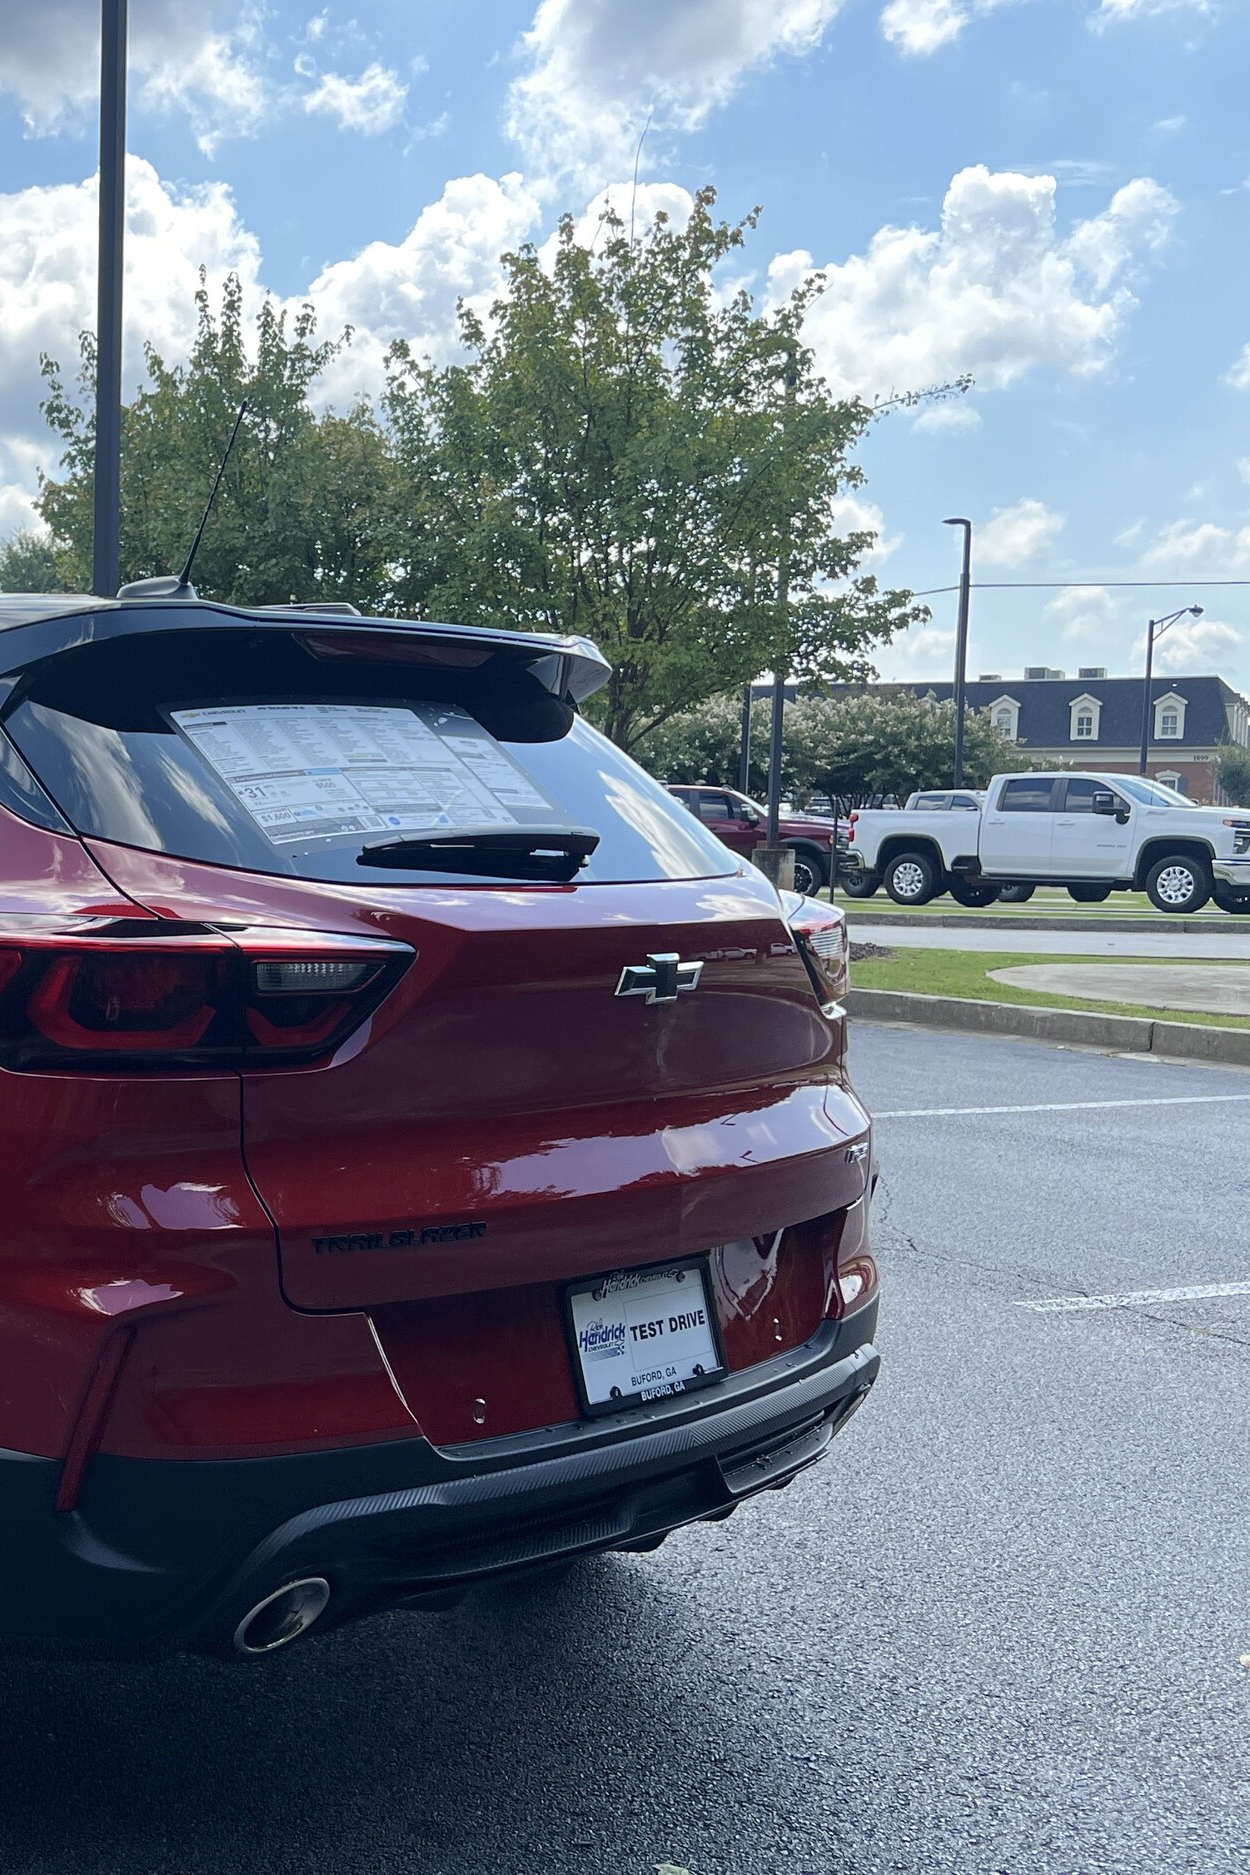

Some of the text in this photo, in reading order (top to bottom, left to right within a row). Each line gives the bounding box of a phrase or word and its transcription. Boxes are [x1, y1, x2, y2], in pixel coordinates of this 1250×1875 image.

[244, 786, 267, 799] 31
[311, 1221, 488, 1255] TRAILBLAZER
[601, 1274, 642, 1298] Hendrick
[579, 1322, 626, 1353] Hendrick
[630, 1309, 706, 1342] TEST DRIVE
[631, 1366, 677, 1387] BUFORD, GA
[640, 1381, 686, 1402] BUFORD, GA
